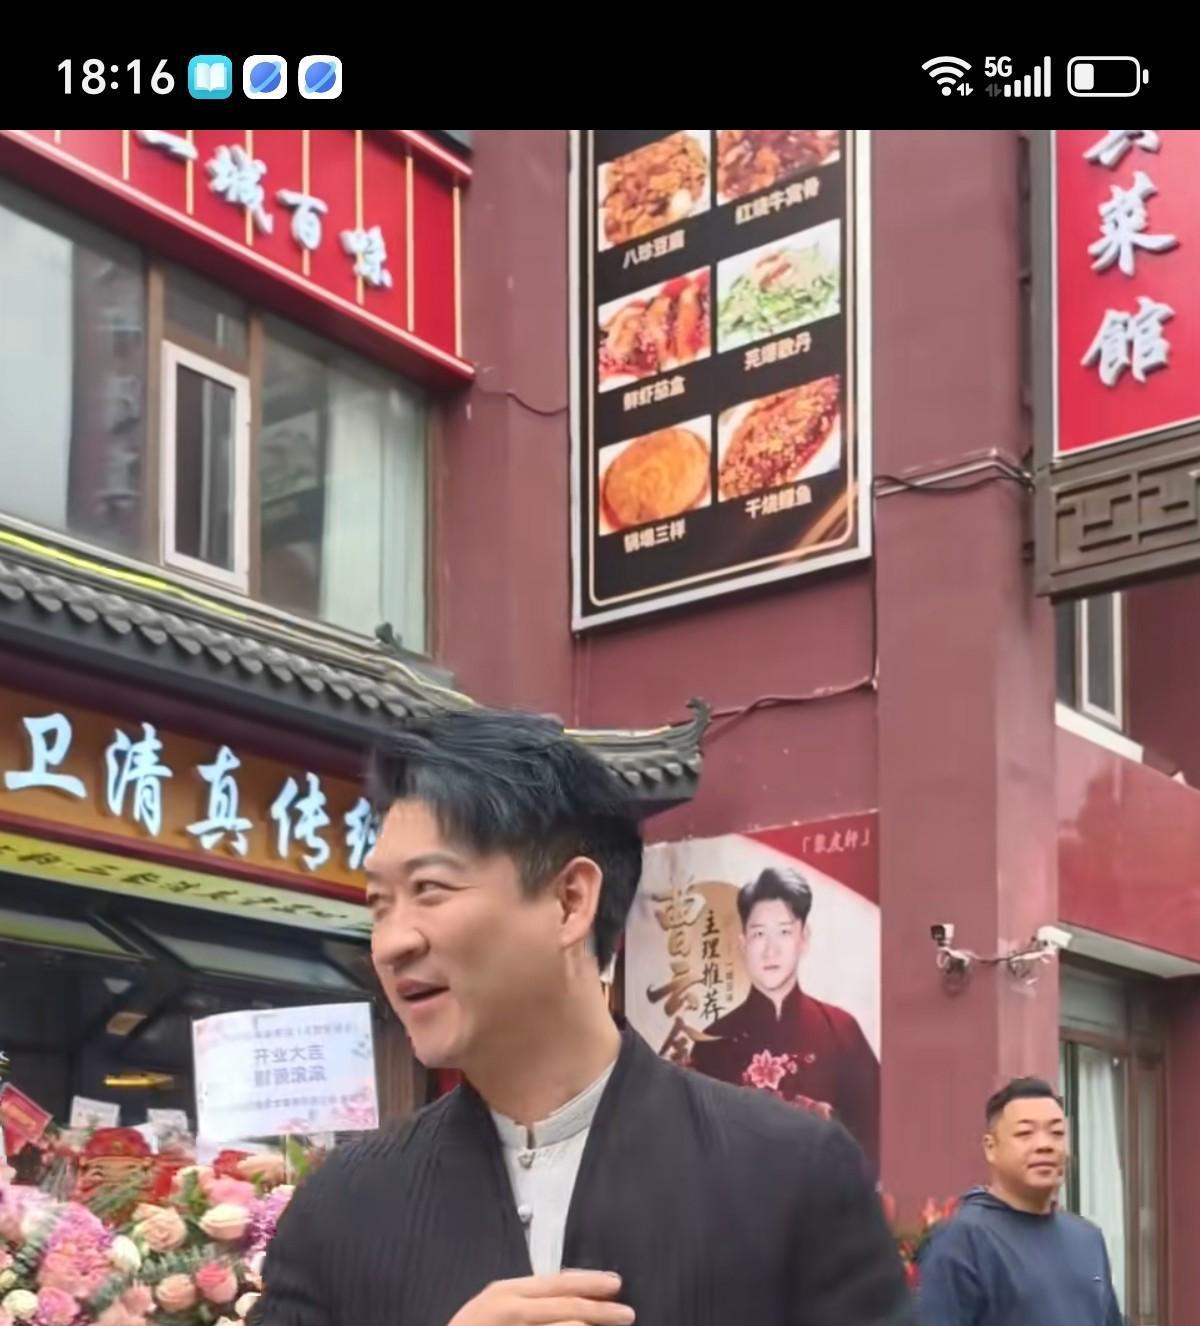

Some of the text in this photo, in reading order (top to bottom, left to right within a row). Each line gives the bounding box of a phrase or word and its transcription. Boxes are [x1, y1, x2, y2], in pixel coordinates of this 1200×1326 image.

[57, 59, 175, 95] 18:16
[984, 56, 1013, 77] 5G
[700, 909, 726, 1021] 主理推荐
